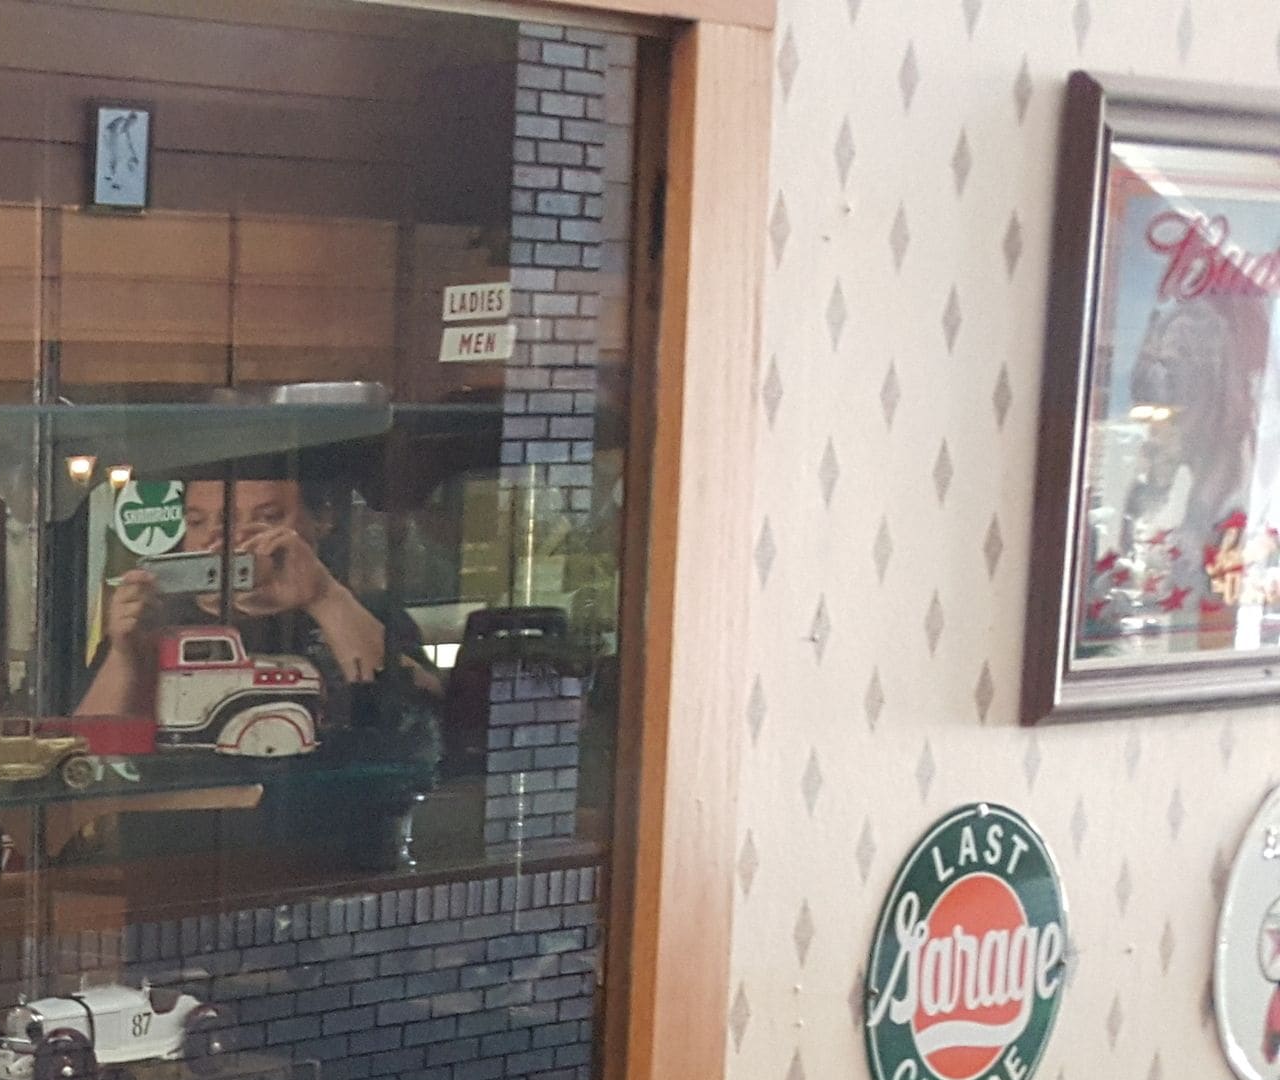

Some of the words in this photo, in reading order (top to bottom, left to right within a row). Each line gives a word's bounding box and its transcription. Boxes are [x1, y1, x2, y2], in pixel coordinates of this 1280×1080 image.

[449, 289, 505, 314] LADIES
[458, 333, 497, 355] MEN
[932, 823, 1029, 883] LAST
[867, 891, 1065, 1038] Garage
[131, 1011, 152, 1038] 87
